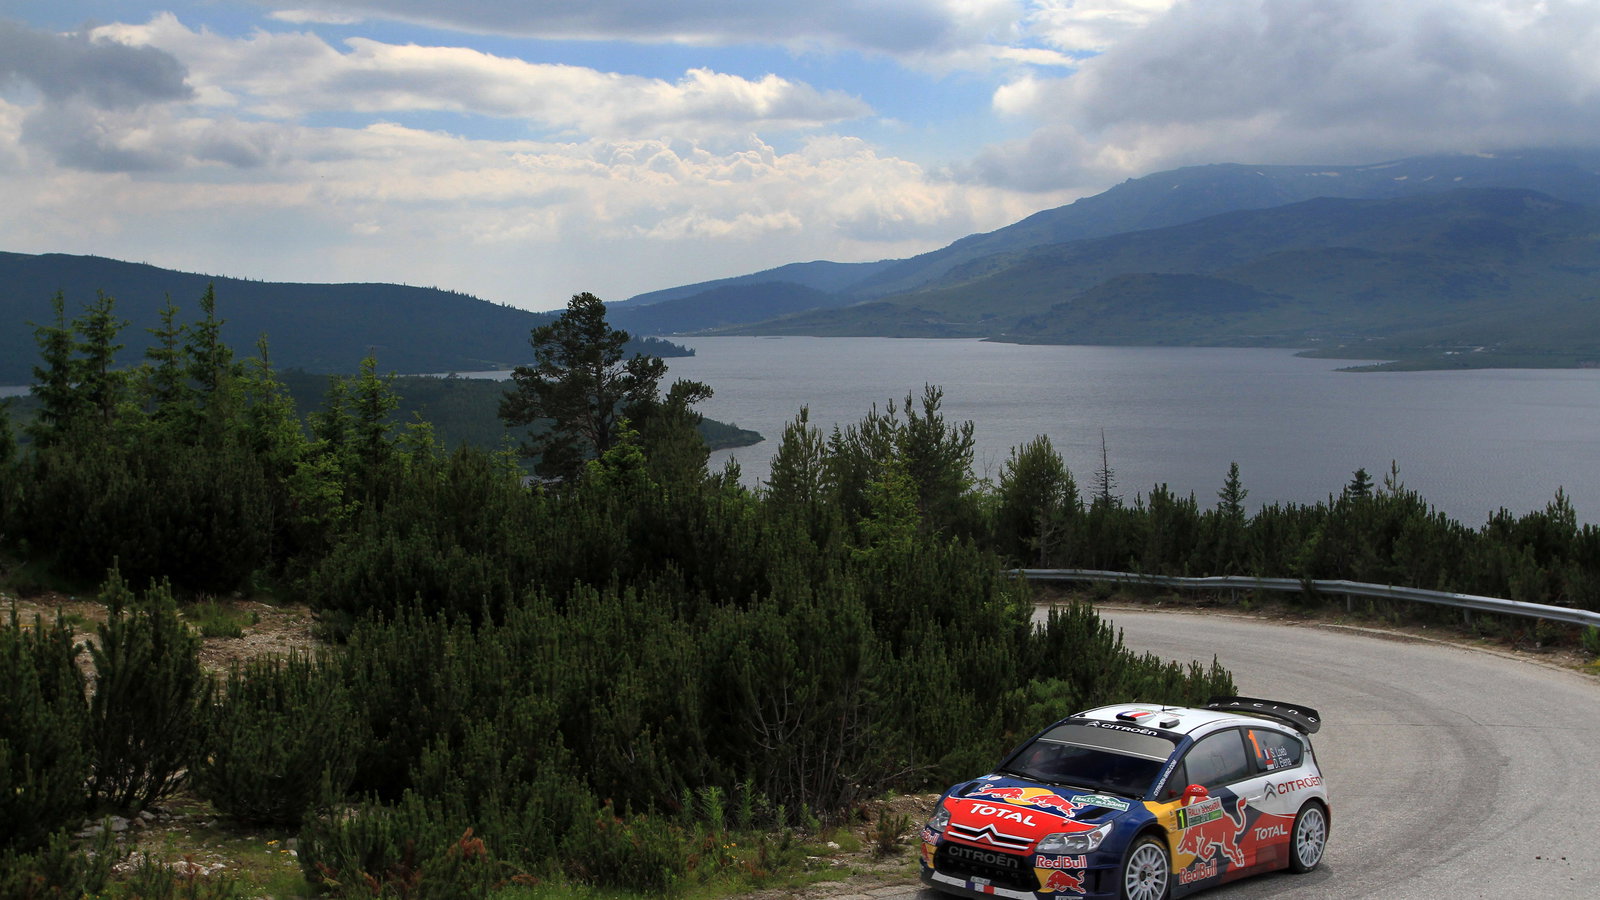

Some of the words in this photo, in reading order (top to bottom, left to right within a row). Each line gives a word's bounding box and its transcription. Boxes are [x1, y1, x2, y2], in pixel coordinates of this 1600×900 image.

[1208, 701, 1318, 723] RACING
[1101, 723, 1158, 737] CITROËN
[1248, 730, 1262, 758] 1
[1275, 746, 1287, 757] Loeb
[1273, 758, 1280, 769] D.
[1277, 774, 1323, 795] CITROËN
[970, 803, 1037, 827] TOTAL
[1178, 809, 1185, 829] 1
[1254, 823, 1288, 841] TOTAL
[948, 846, 1018, 868] CITROËN
